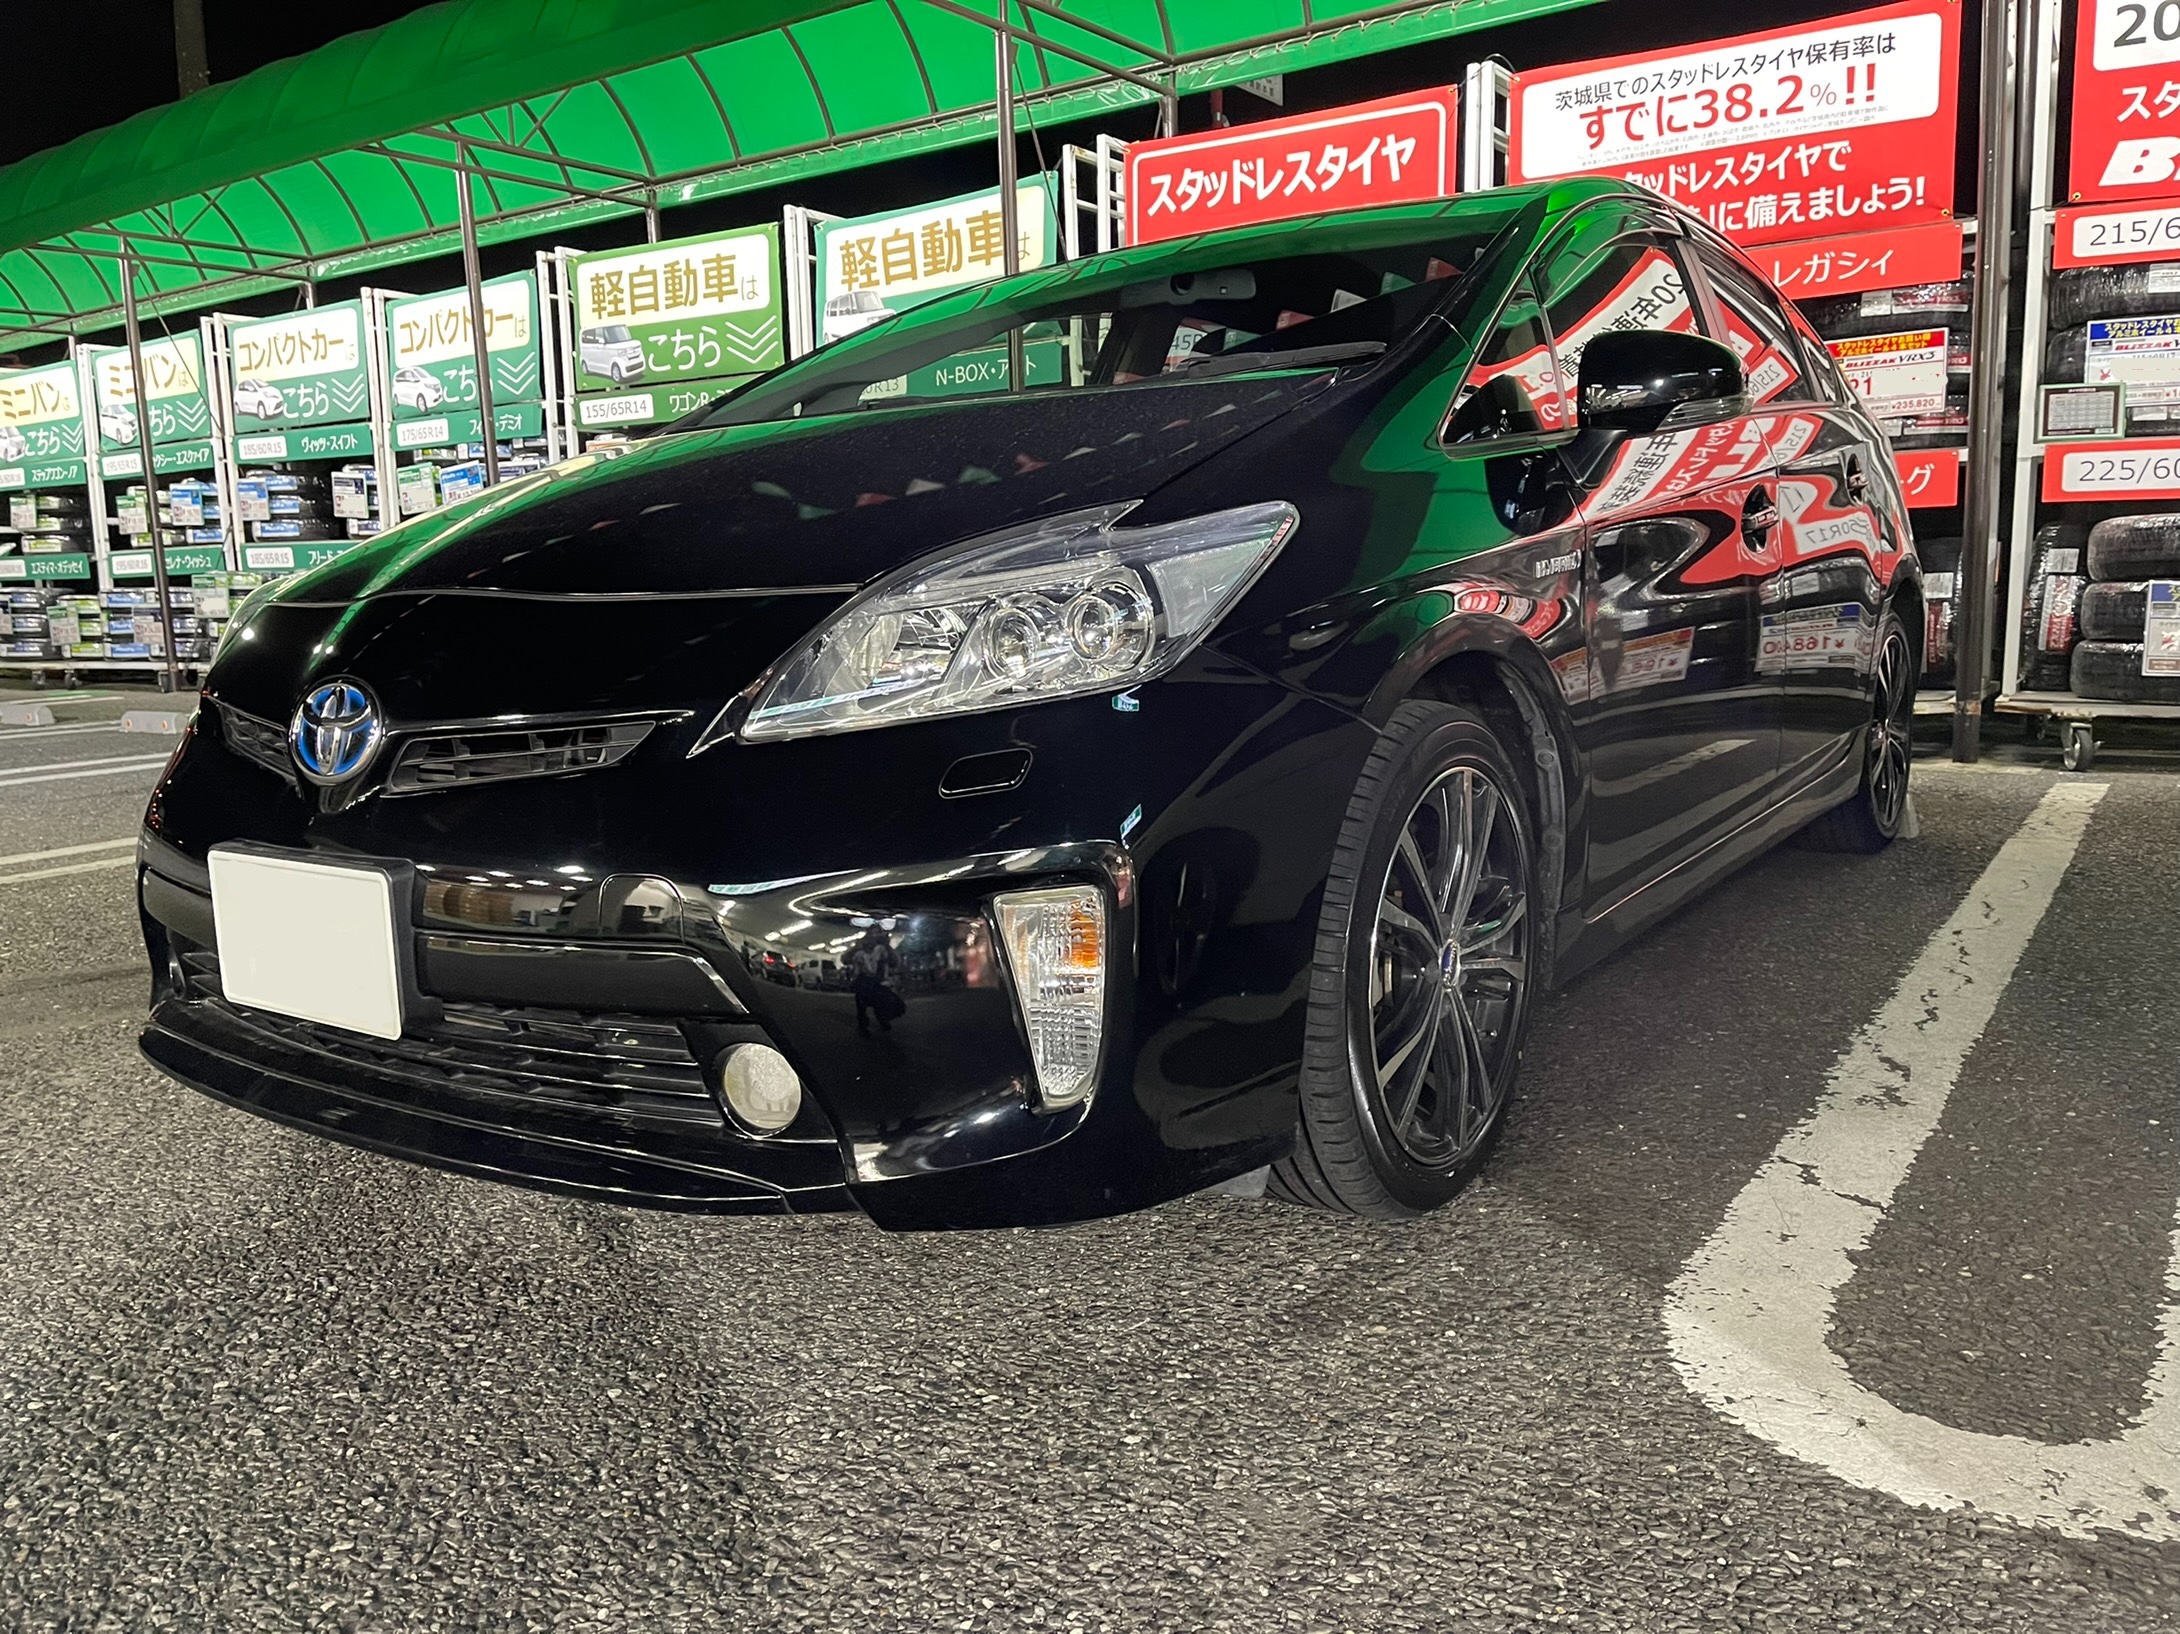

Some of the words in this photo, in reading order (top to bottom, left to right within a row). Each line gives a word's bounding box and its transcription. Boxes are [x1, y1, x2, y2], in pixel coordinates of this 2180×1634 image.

[1555, 33, 1897, 111] 茨城県でのスタッドレスタイヤ保有率は
[1147, 133, 1416, 217] スタッドレスタイヤ
[840, 209, 1031, 292] 軽自動車は
[590, 253, 759, 320] 軽自動車は
[239, 328, 355, 372] コンパクトカーは
[648, 325, 721, 372] こちら
[444, 364, 493, 403] こち
[935, 354, 1037, 386] N-BOX・アト
[282, 381, 329, 418] こちら
[586, 399, 647, 419] 155/65R14
[149, 403, 176, 436] ちら
[402, 425, 444, 441] 175/65R14
[25, 427, 60, 456] こちら
